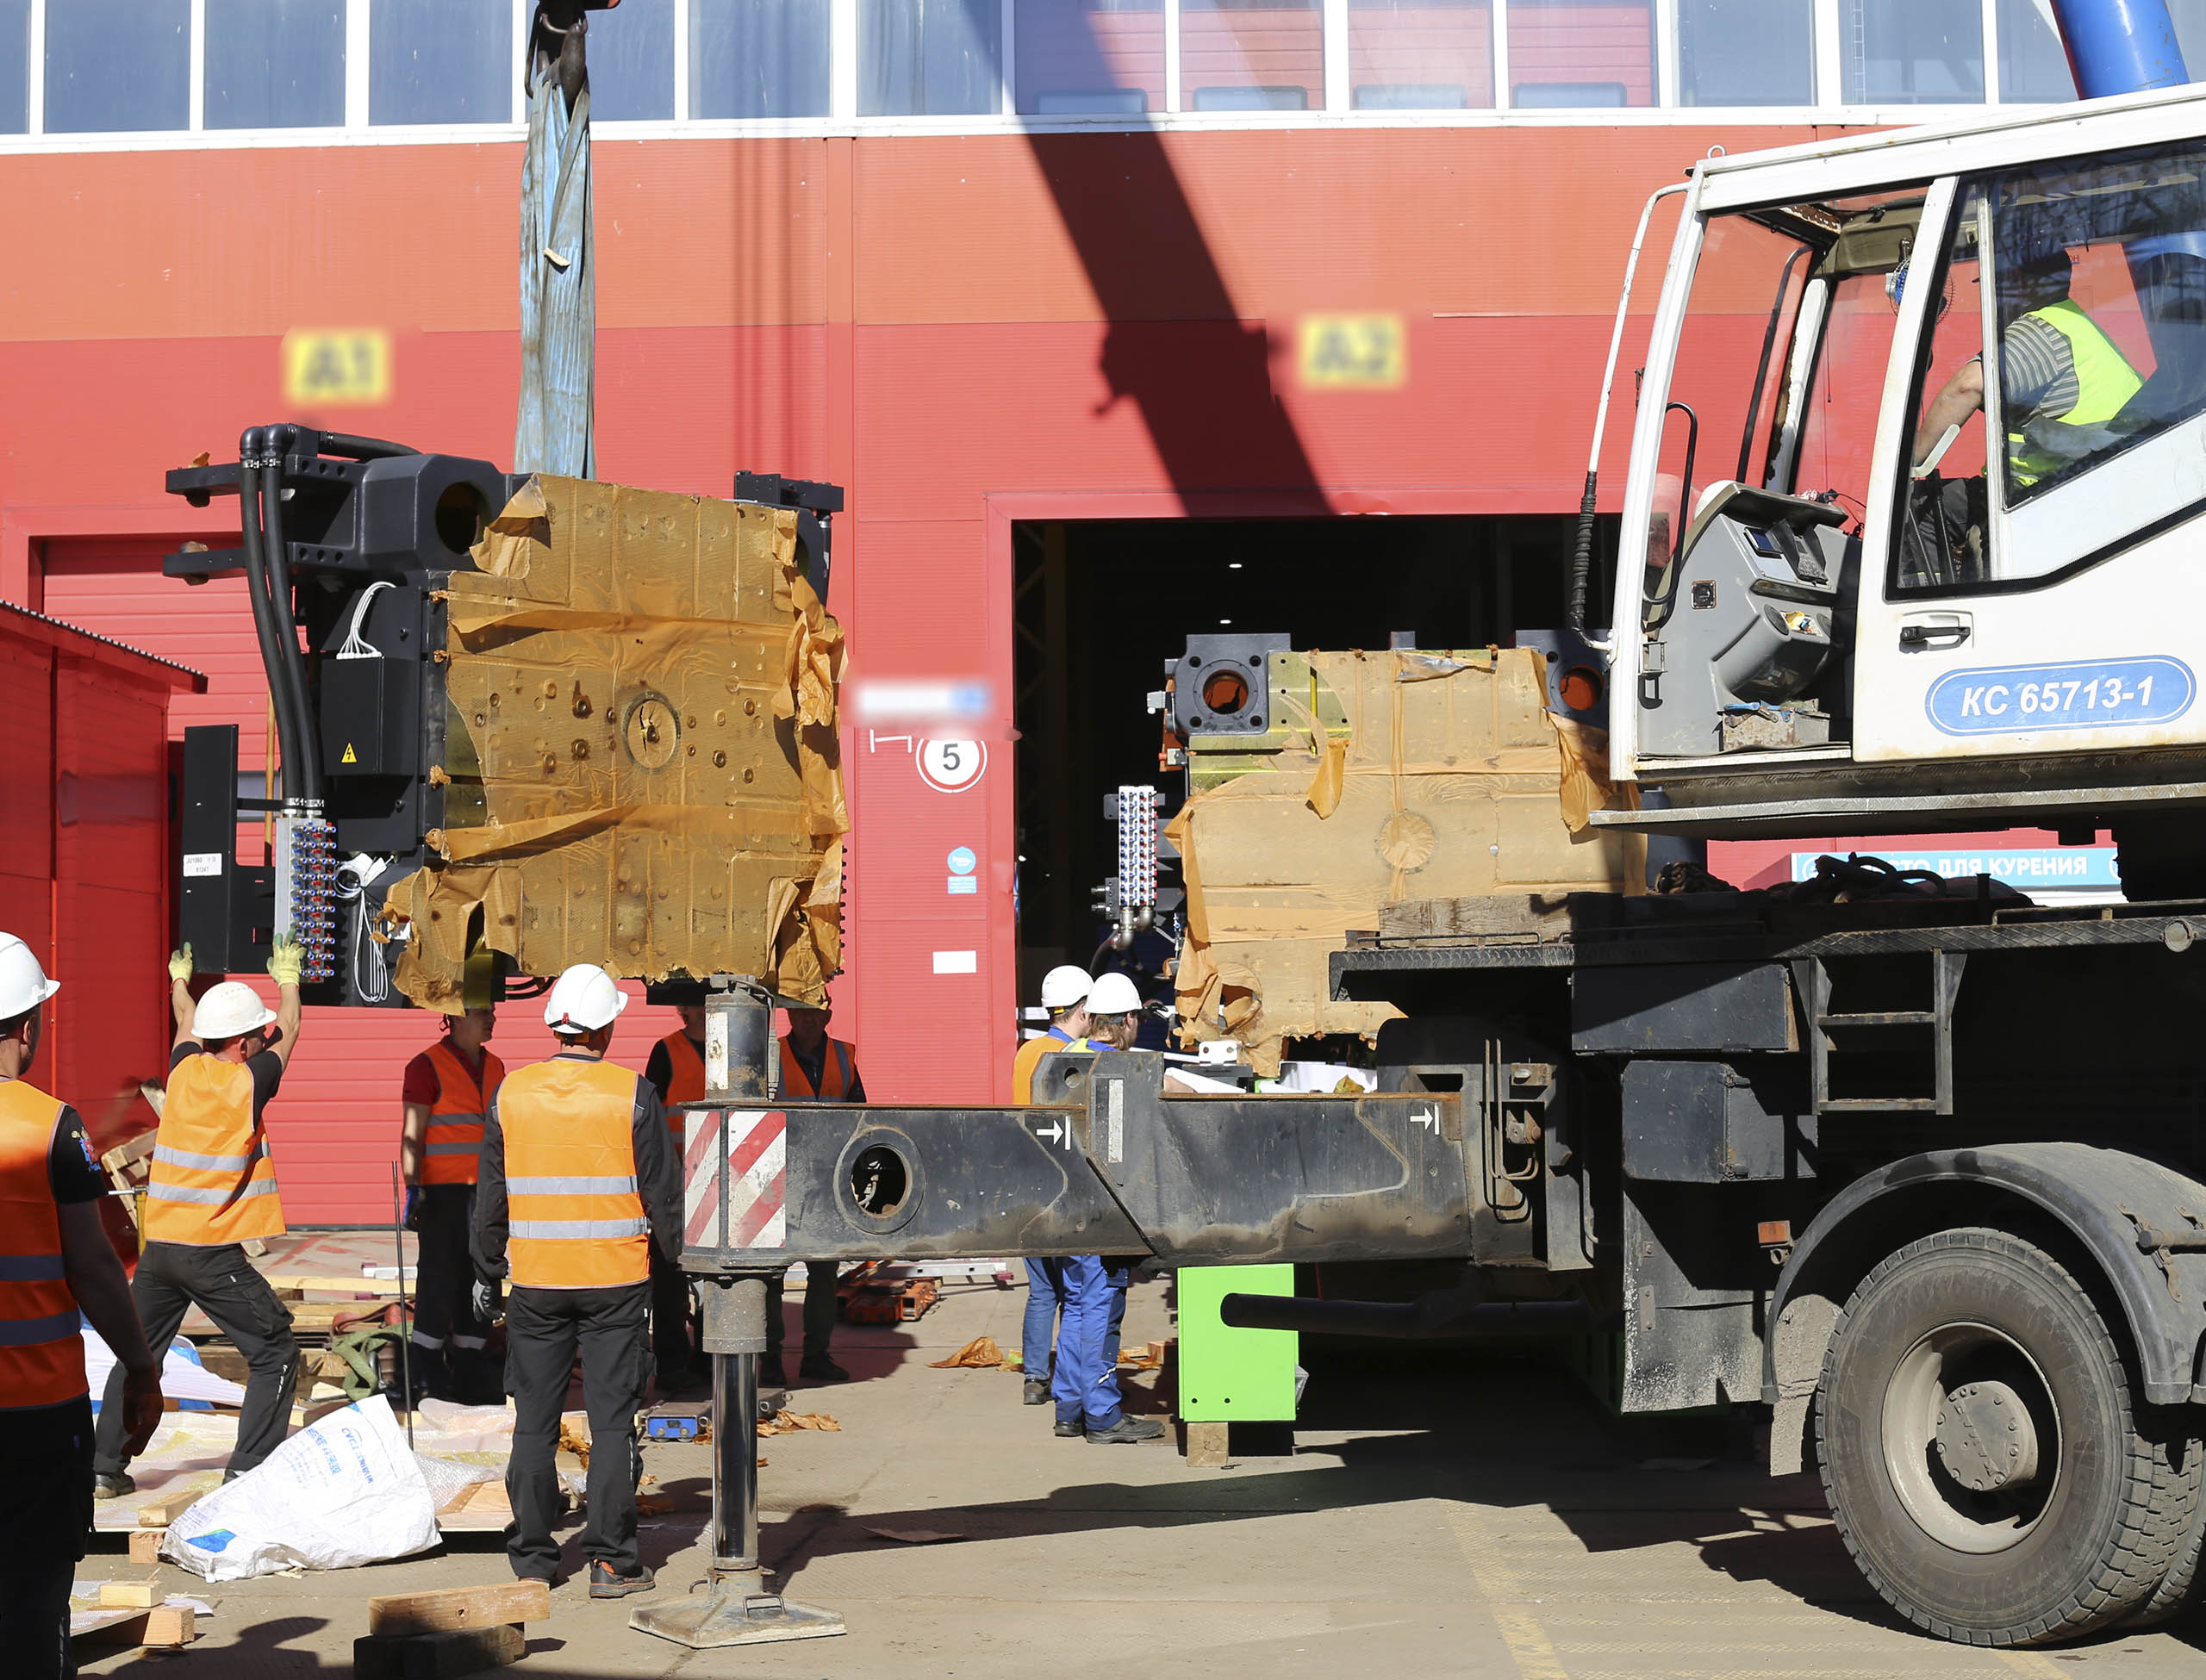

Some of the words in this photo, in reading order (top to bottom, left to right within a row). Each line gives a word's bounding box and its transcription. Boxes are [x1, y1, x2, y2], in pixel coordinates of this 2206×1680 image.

[2020, 675, 2154, 713] 65713-1
[943, 743, 961, 771] 5
[1939, 858, 1982, 878] ДЛЯ
[1989, 856, 2088, 876] КУРЕНИЯ
